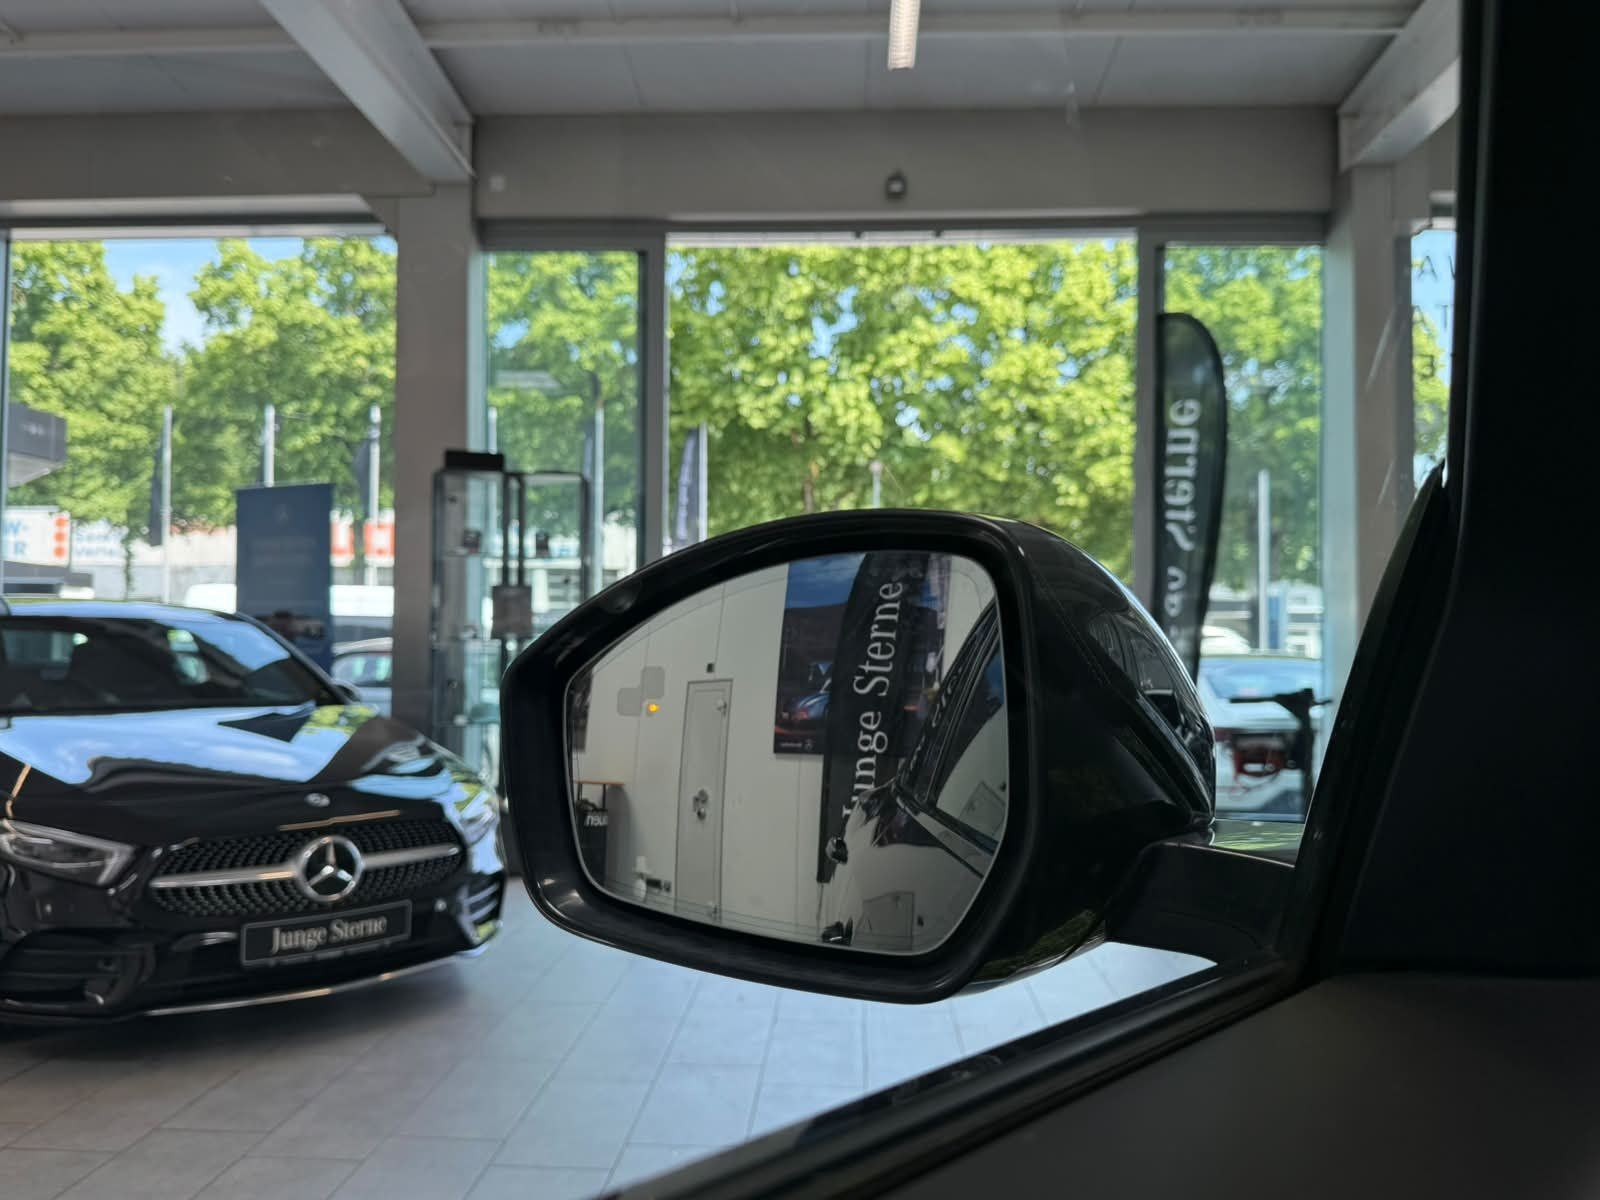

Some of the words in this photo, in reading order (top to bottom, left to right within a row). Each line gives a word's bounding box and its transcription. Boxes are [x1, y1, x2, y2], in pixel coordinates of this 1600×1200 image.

[853, 582, 903, 697] Sterne
[272, 927, 328, 954] Junge
[329, 916, 387, 942] Sterne
